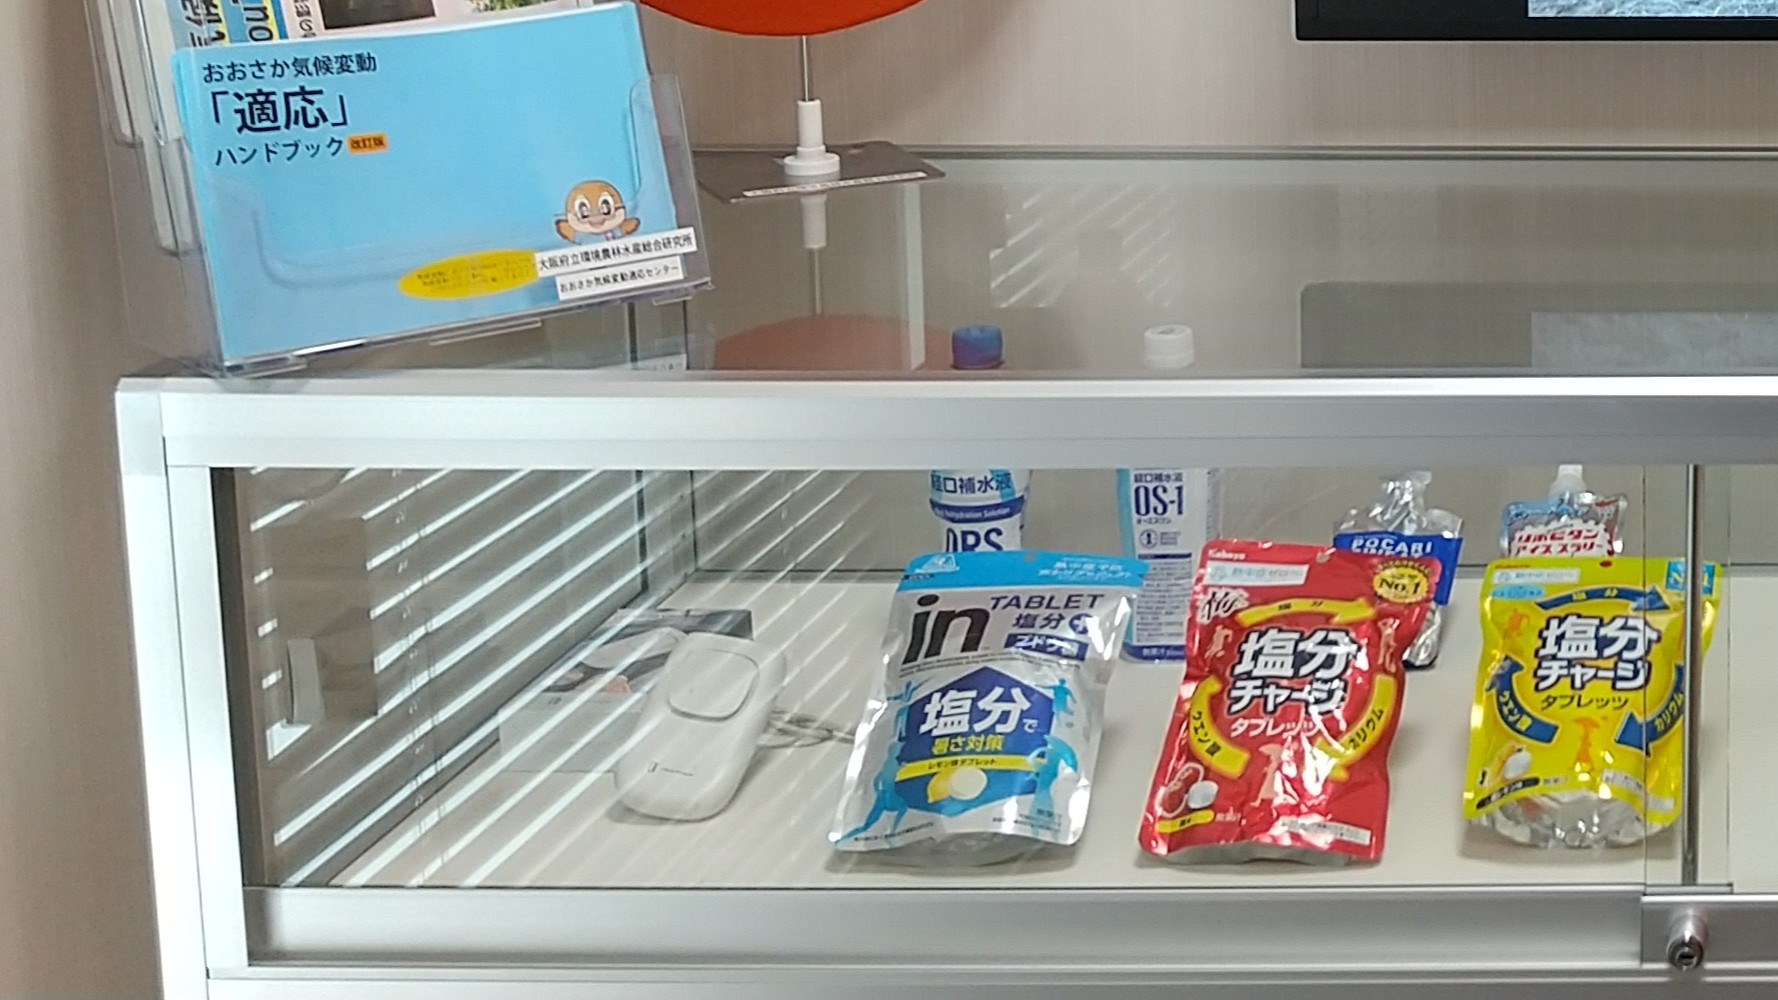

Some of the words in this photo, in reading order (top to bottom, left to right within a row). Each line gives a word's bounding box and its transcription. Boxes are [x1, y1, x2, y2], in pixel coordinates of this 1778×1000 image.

[203, 52, 378, 83] おおさか気候変動
[211, 85, 348, 135] 「適応」
[215, 137, 343, 166] ハンドブック
[538, 235, 693, 271] 大阪府立環境農林水産総合研究所
[559, 265, 680, 292] おおさか気候変動適応センター
[931, 471, 1012, 494] 経口補水液
[1134, 485, 1183, 516] OS-1
[1351, 538, 1433, 555] POCARI
[1517, 529, 1600, 543] リポビタン
[1379, 578, 1421, 595] No.1
[990, 594, 1105, 611] TABLET
[901, 593, 991, 666] in
[1012, 612, 1066, 629] 塩分
[1538, 614, 1660, 660] 塩分
[1233, 628, 1359, 679] 塩分
[1535, 660, 1650, 691] チャージ
[1229, 678, 1346, 714] チャージ
[1541, 694, 1629, 710] タブレッツ
[931, 733, 1005, 755] 暑さ対策
